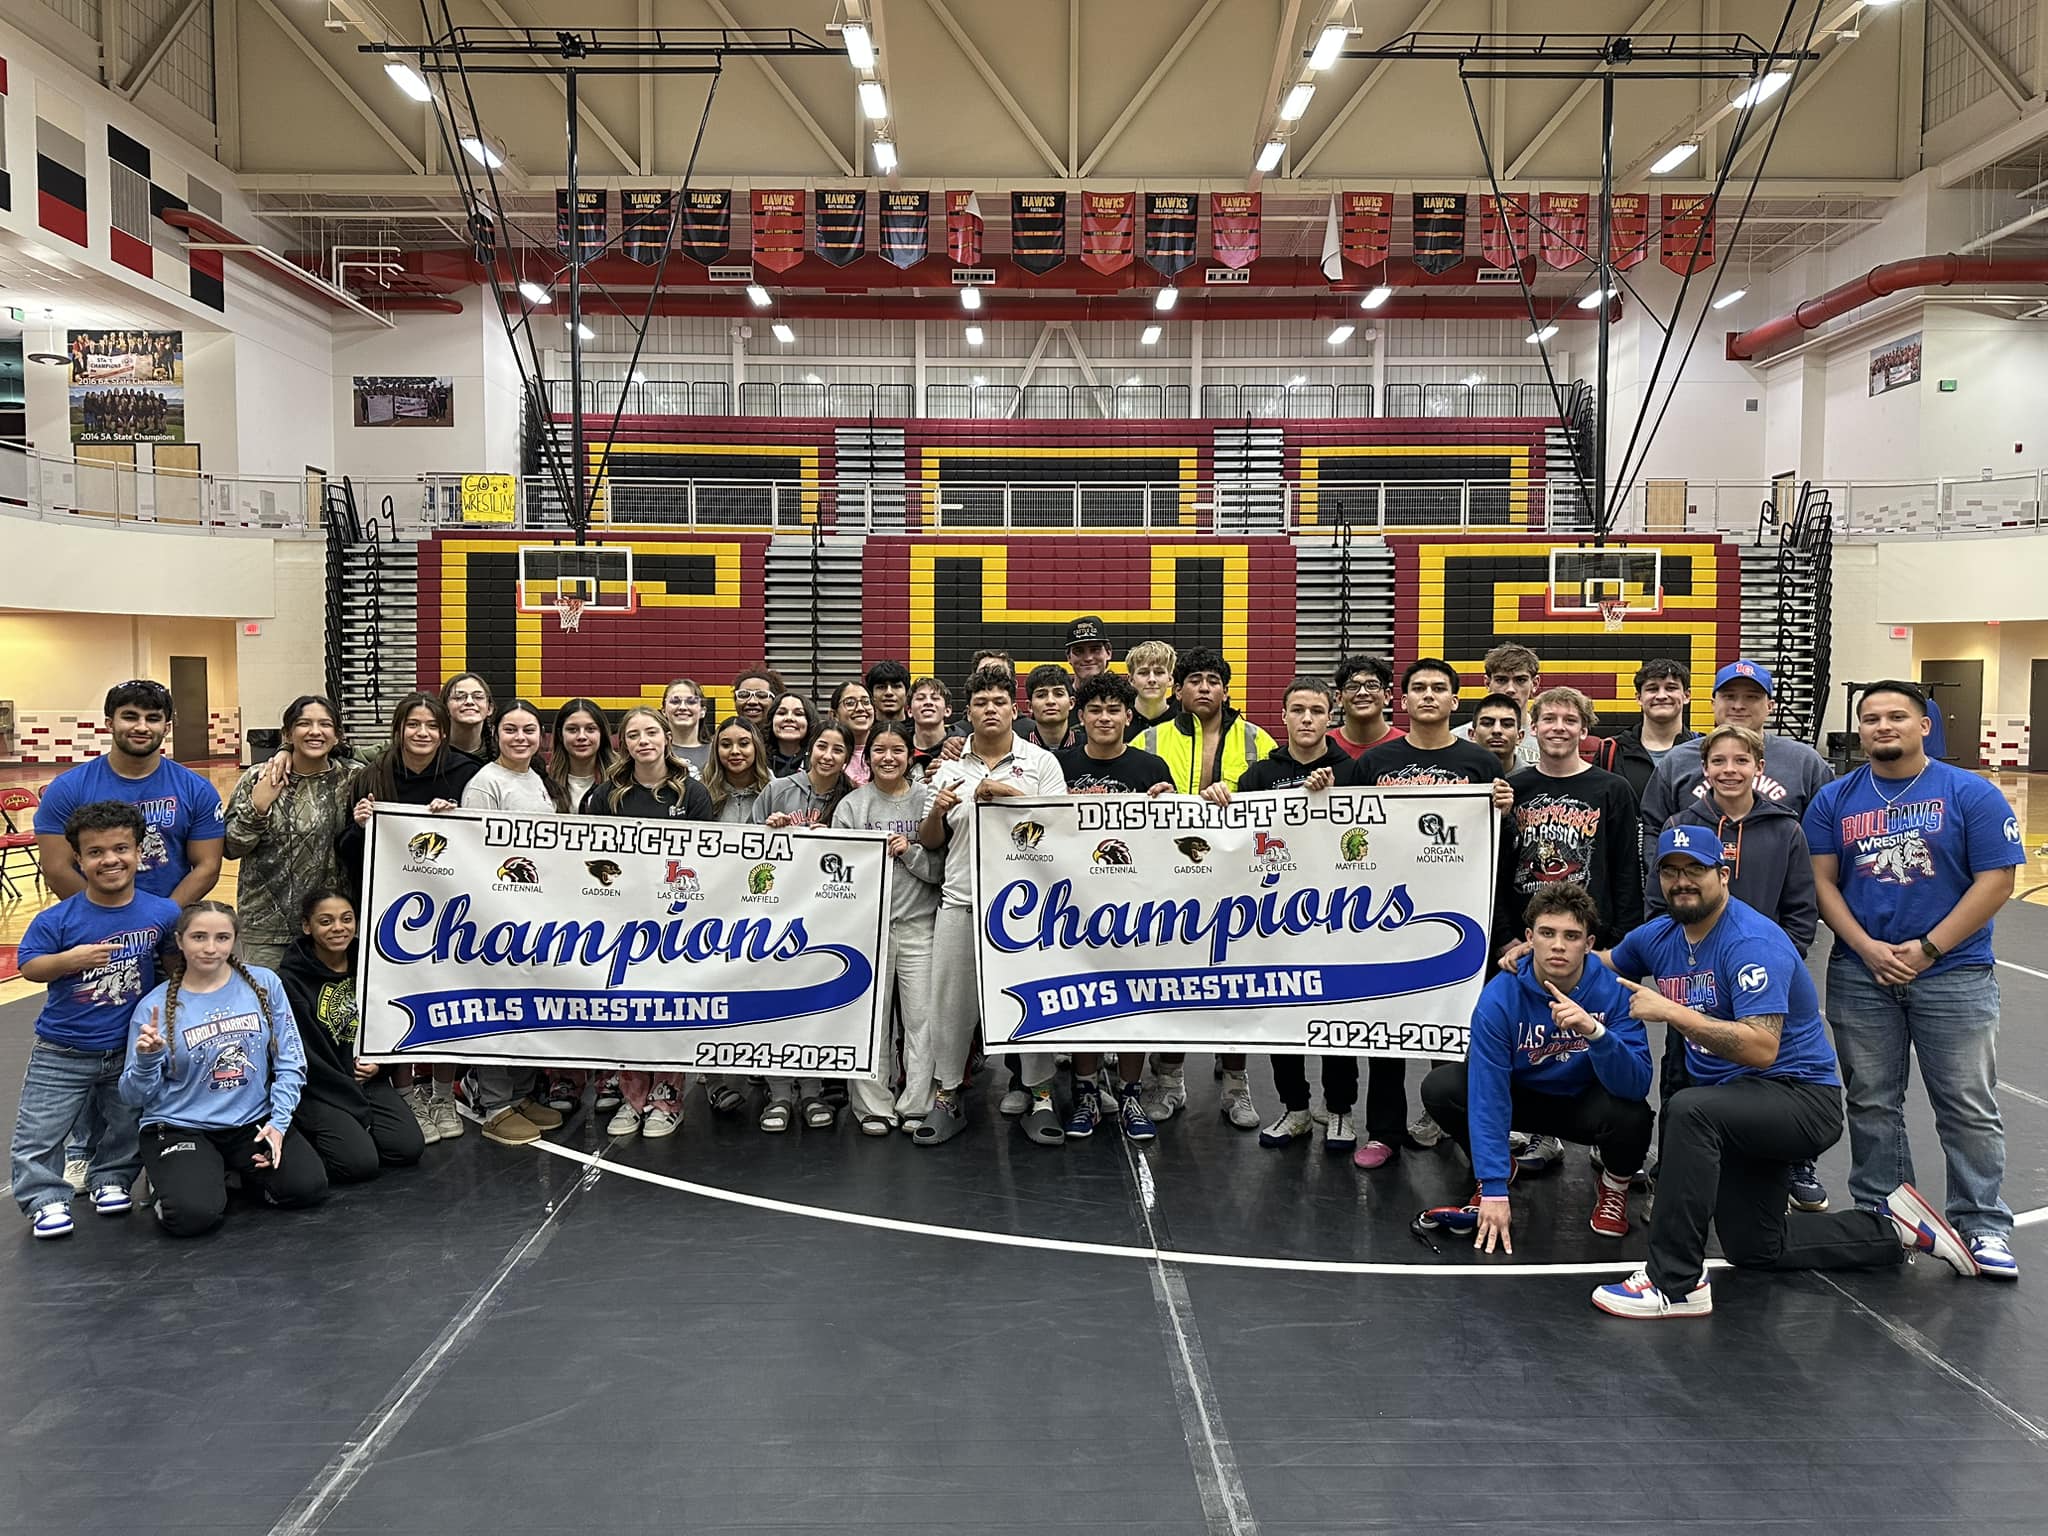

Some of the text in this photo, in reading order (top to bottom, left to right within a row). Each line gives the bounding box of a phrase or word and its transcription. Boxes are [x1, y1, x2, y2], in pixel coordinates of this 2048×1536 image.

[631, 193, 661, 204] HAWKS
[691, 193, 721, 204] HAWKS
[761, 194, 794, 205] HAWKS
[825, 193, 855, 204] HAWKS
[889, 195, 919, 206] HAWKS
[1022, 196, 1055, 207] HAWKS
[1092, 197, 1124, 208] HAWKS
[1155, 197, 1188, 208] HAWKS
[1220, 197, 1251, 207] HAWKS
[1352, 196, 1382, 207] HAWKS
[1423, 197, 1455, 208] HAWKS
[1549, 197, 1578, 208] HAWKS
[134, 432, 176, 441] Champions
[463, 493, 515, 513] WRESTLING
[1078, 795, 1386, 831] DISTRICT 3-5A
[1841, 799, 1944, 845] BULLDAWG
[485, 818, 793, 861] DISTRICT 3-5A
[1523, 823, 1580, 849] CLASSIC
[1673, 829, 1690, 847] LA
[1857, 828, 1920, 852] WRESTLING
[1423, 847, 1456, 855] ORGAN
[1006, 853, 1054, 862] ALAMOGORDO
[1416, 854, 1464, 863] MOUNTAIN
[402, 864, 454, 876] ALAMOGORDO
[1089, 866, 1138, 875] CENTENNIAL
[1174, 865, 1212, 873] GADSDEN
[1249, 863, 1297, 872] LAS CRUCES
[1335, 862, 1376, 871] MAYFIELD
[492, 883, 543, 894] CENTENNIAL
[581, 887, 621, 897] GADSDEN
[822, 884, 850, 892] ORGAN
[657, 891, 705, 901] LAS CRUCES
[740, 895, 779, 904] MAYFIELD
[815, 891, 856, 900] MOUNTAIN
[985, 871, 1416, 967] Champions
[374, 890, 809, 989] Champions
[1739, 966, 1767, 992] NF
[1037, 970, 1323, 1016] BOYS WRESTLING
[427, 995, 729, 1028] GIRLS WRESTLING
[184, 1023, 218, 1048] HAROLD
[219, 1013, 261, 1032] HARRISON
[1517, 1022, 1545, 1052] LAS
[695, 1042, 857, 1072] 2024-2025
[219, 1080, 240, 1089] 2024
